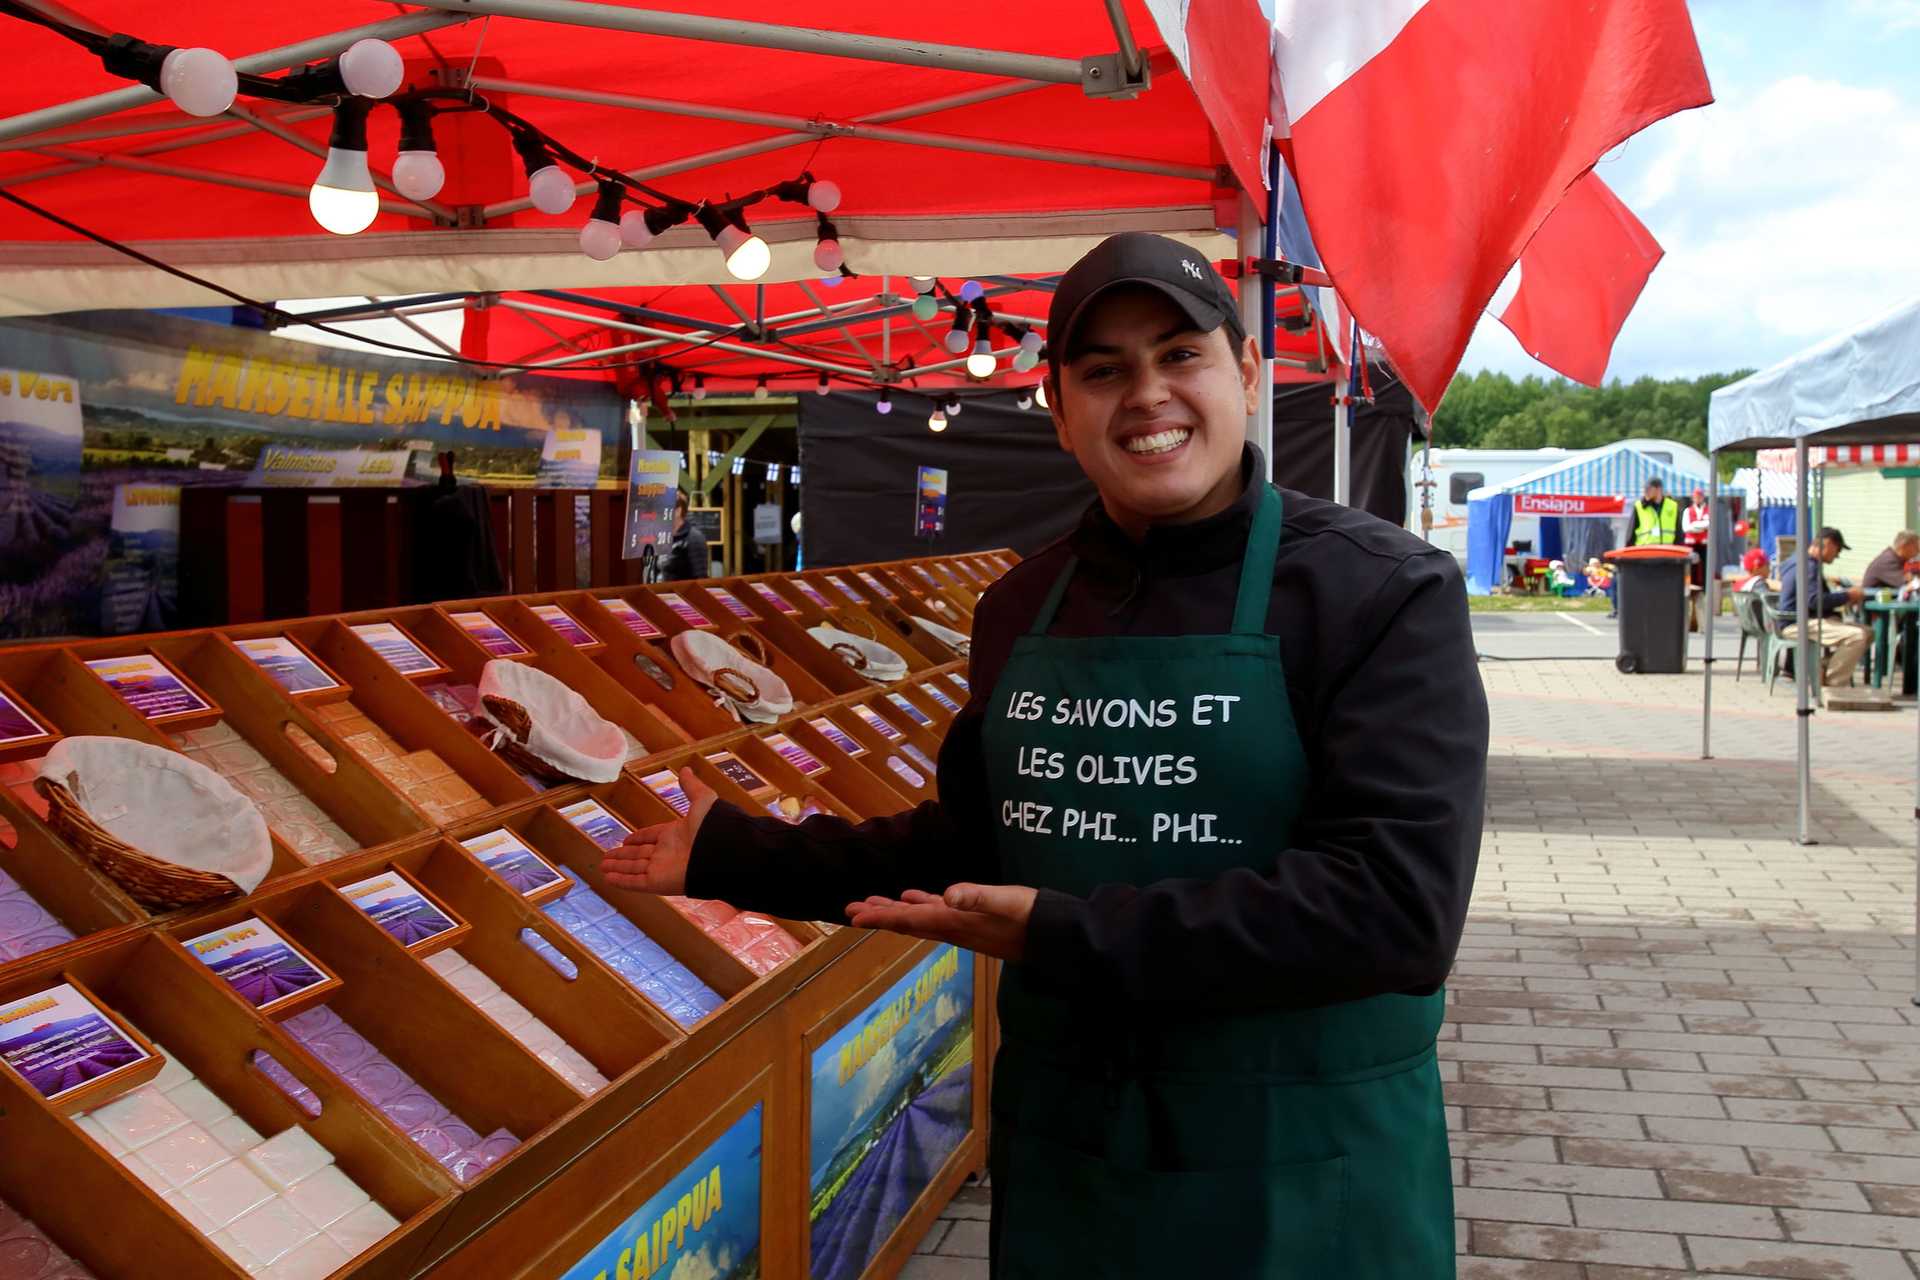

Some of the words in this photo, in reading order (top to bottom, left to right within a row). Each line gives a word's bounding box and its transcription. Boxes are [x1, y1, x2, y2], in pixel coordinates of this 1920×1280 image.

[1521, 495, 1585, 515] Ensiapu
[1007, 691, 1046, 721] LES
[1051, 698, 1178, 728] SAVONS
[1192, 694, 1241, 725] ET
[1018, 746, 1065, 779] LES
[1076, 754, 1198, 786] OLIVES
[1002, 799, 1054, 834] CHEZ
[1062, 808, 1137, 841] PHI...
[1152, 812, 1243, 845] PHI...
[838, 986, 914, 1089] MARSEILLE
[913, 944, 959, 1016] SAIPPUA
[614, 1164, 723, 1280] SAIPPUA
